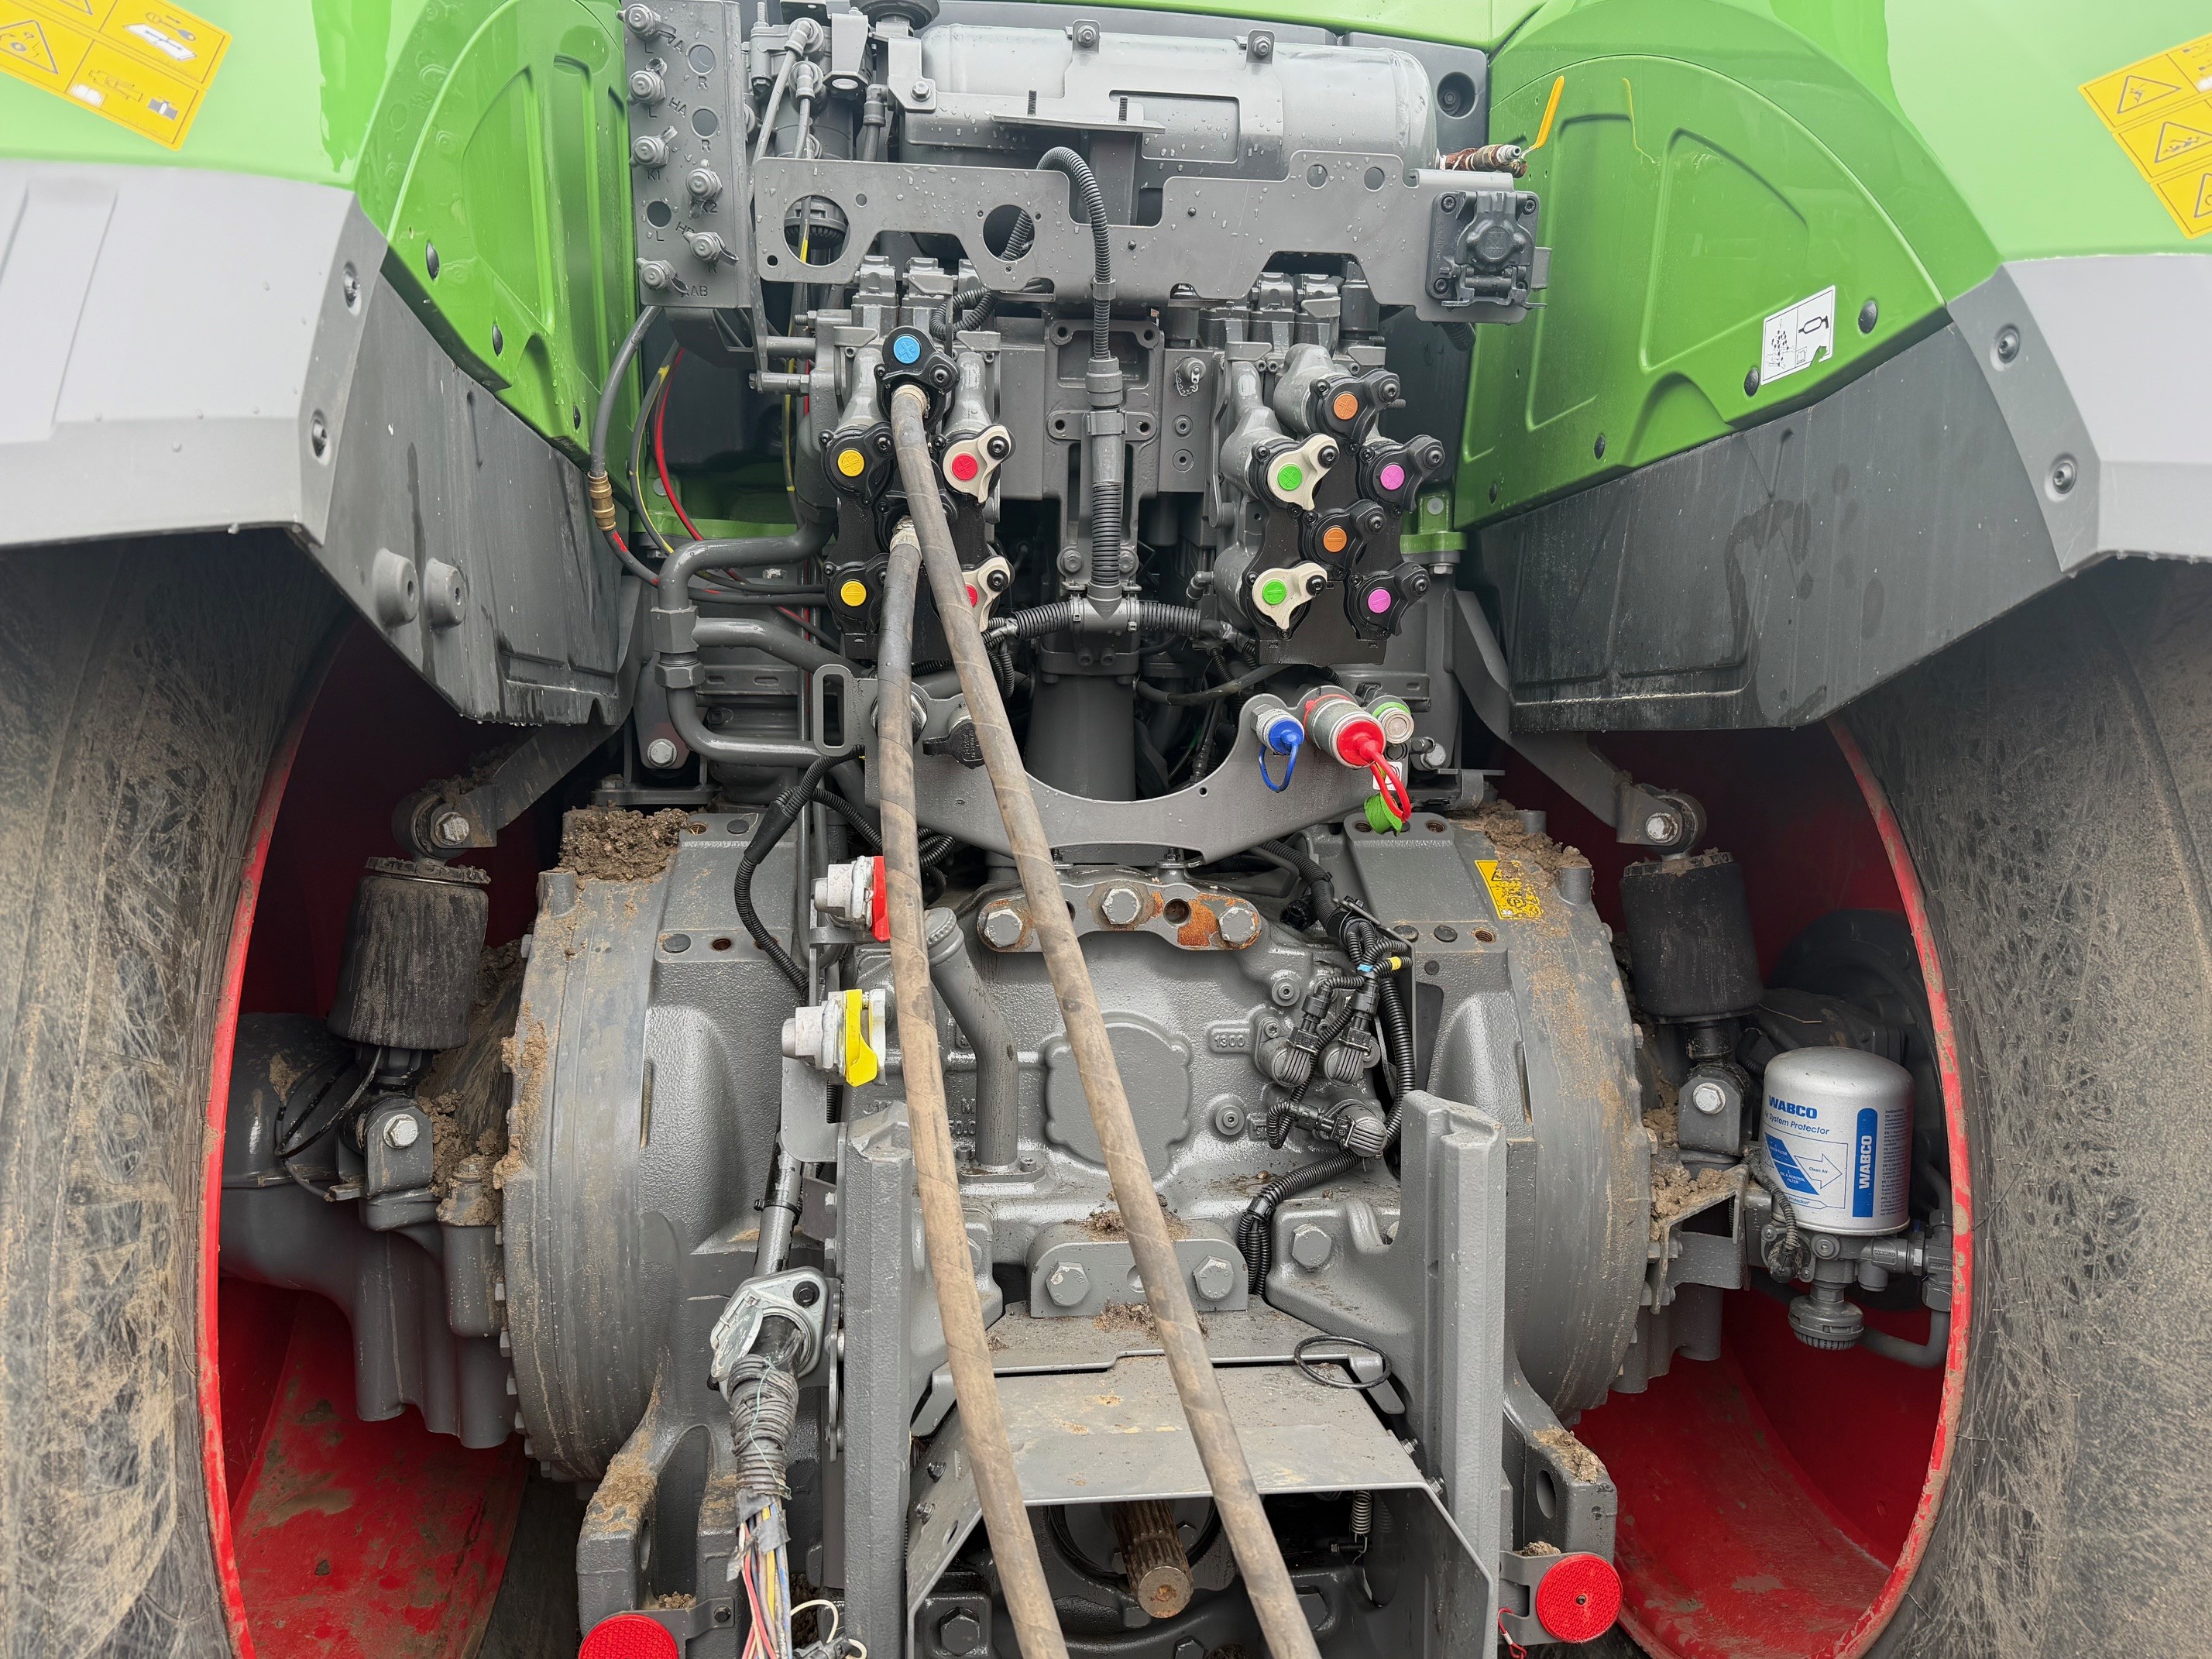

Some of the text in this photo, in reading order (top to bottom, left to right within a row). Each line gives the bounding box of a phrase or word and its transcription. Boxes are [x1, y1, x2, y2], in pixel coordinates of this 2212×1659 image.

[698, 75, 708, 90] R
[648, 106, 658, 118] L
[668, 97, 688, 118] HA
[701, 139, 711, 152] R
[655, 230, 665, 242] L
[1214, 1034, 1245, 1048] 1300
[1768, 1094, 1818, 1119] WABCO
[1769, 1112, 1789, 1127] System
[1791, 1121, 1830, 1135] Protector
[1858, 1135, 1873, 1190] WABCO
